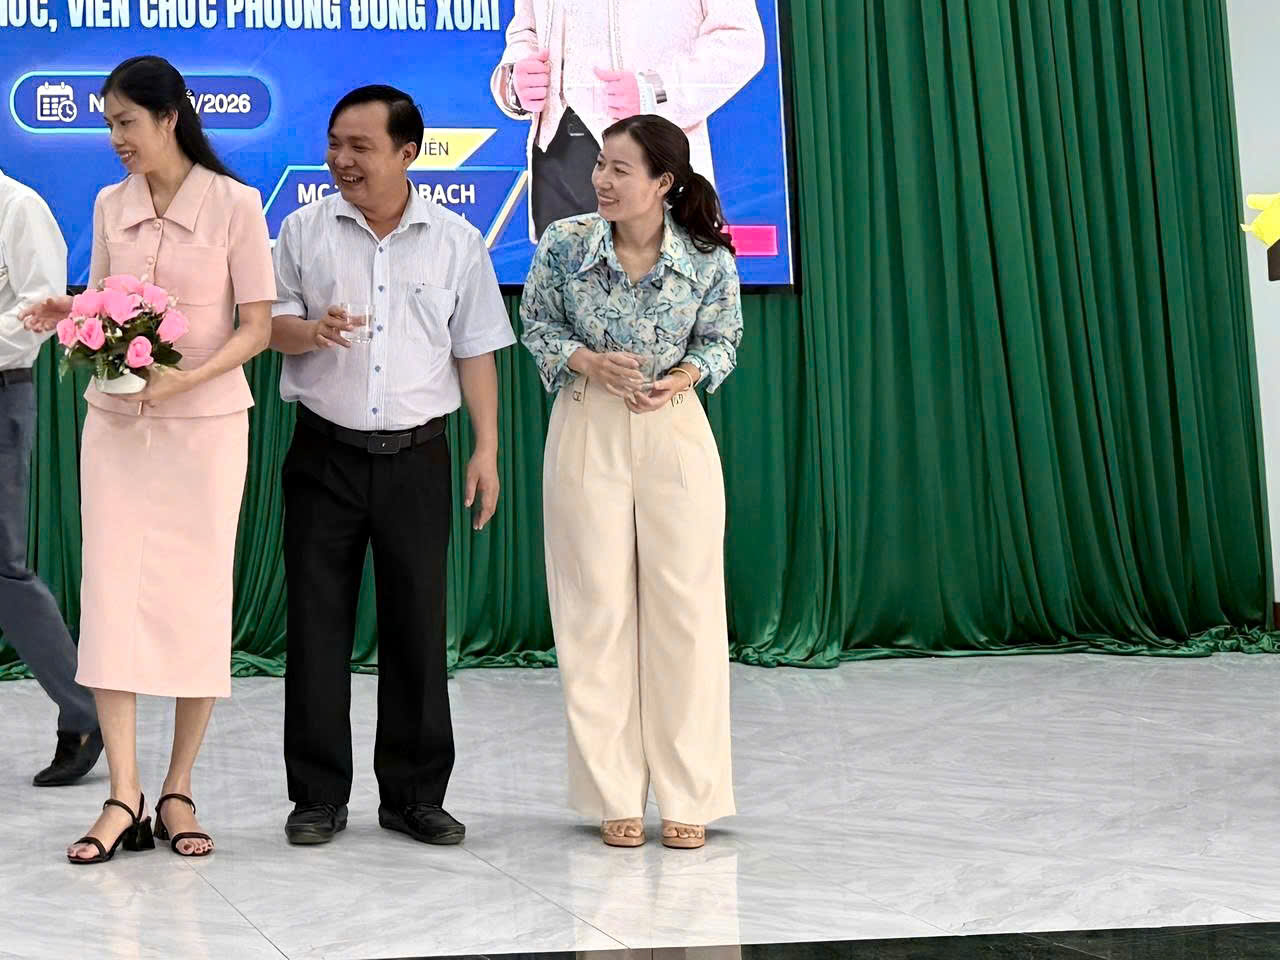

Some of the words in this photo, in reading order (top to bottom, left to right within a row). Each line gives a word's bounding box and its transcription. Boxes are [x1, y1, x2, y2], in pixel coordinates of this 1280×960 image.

[190, 93, 251, 114] /2026
[424, 137, 449, 156] IÊN
[297, 183, 331, 204] MC
